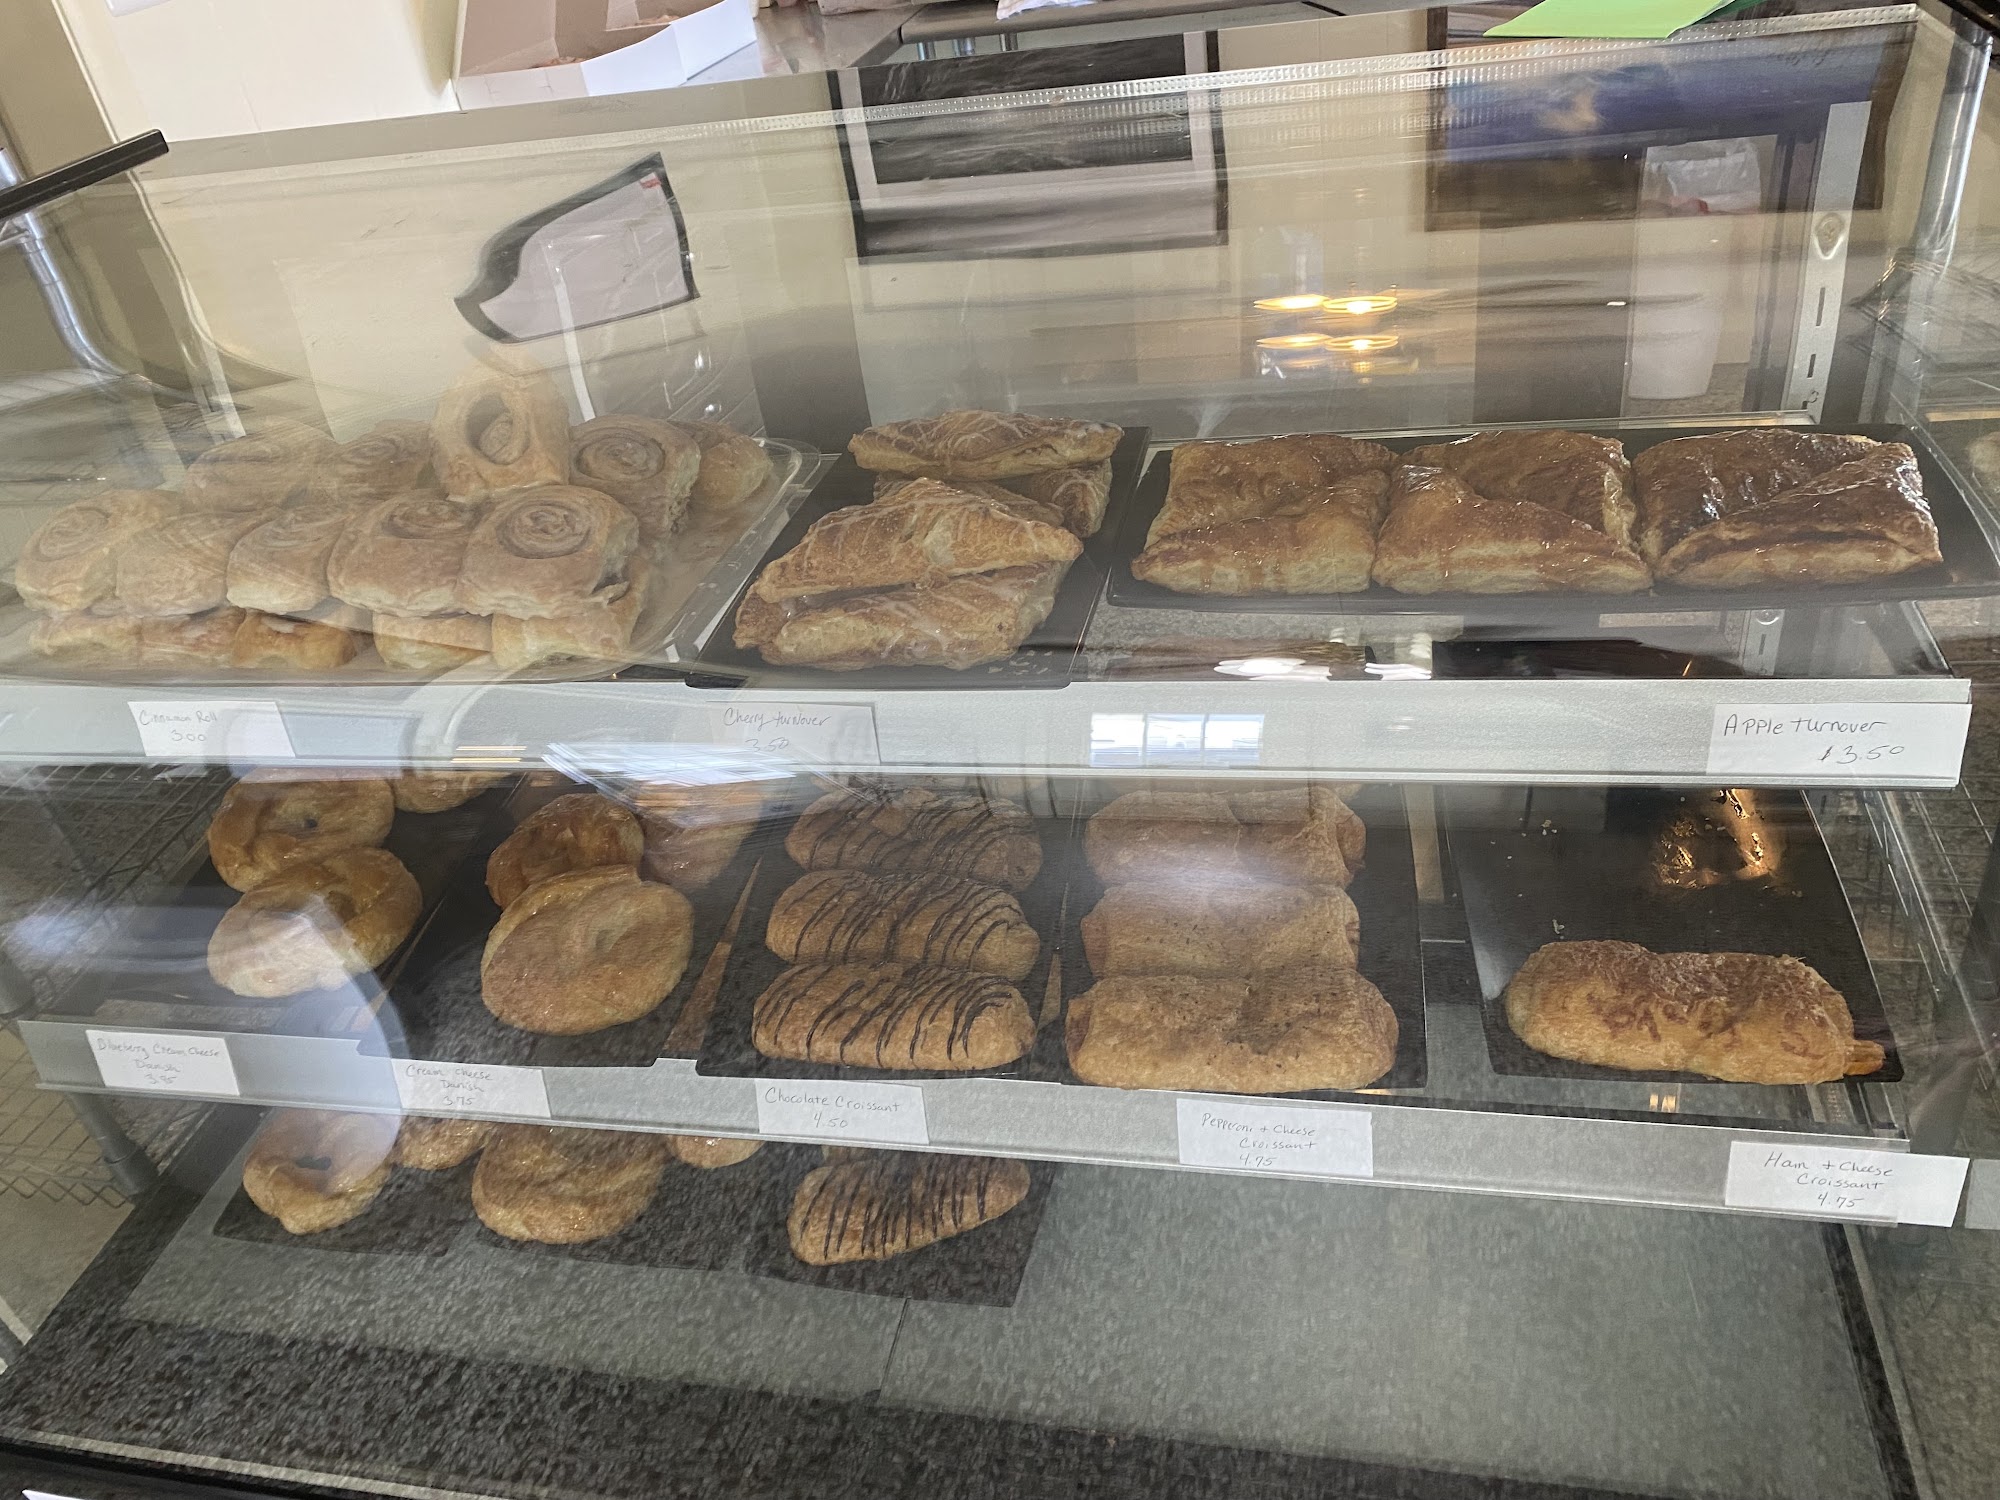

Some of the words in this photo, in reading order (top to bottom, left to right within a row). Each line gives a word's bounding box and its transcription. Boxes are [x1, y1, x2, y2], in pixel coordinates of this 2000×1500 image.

[139, 710, 192, 726] Cinnamon
[195, 710, 218, 723] Roll
[723, 707, 771, 732] Cherry
[152, 1043, 186, 1056] Cream
[405, 1064, 446, 1077] Cream
[440, 1079, 485, 1093] Danish
[764, 1086, 830, 1106] Chocolate
[835, 1095, 901, 1113] Croissant
[1201, 1112, 1253, 1133] Pepperoni
[1273, 1124, 1317, 1137] Cheese
[1239, 1137, 1318, 1150] Croissant
[1764, 1151, 1809, 1169] Ham
[1821, 1159, 1836, 1171] +
[1839, 1161, 1893, 1177] Cheese
[1796, 1173, 1885, 1191] Croissant
[1817, 1191, 1864, 1208] 4.75
